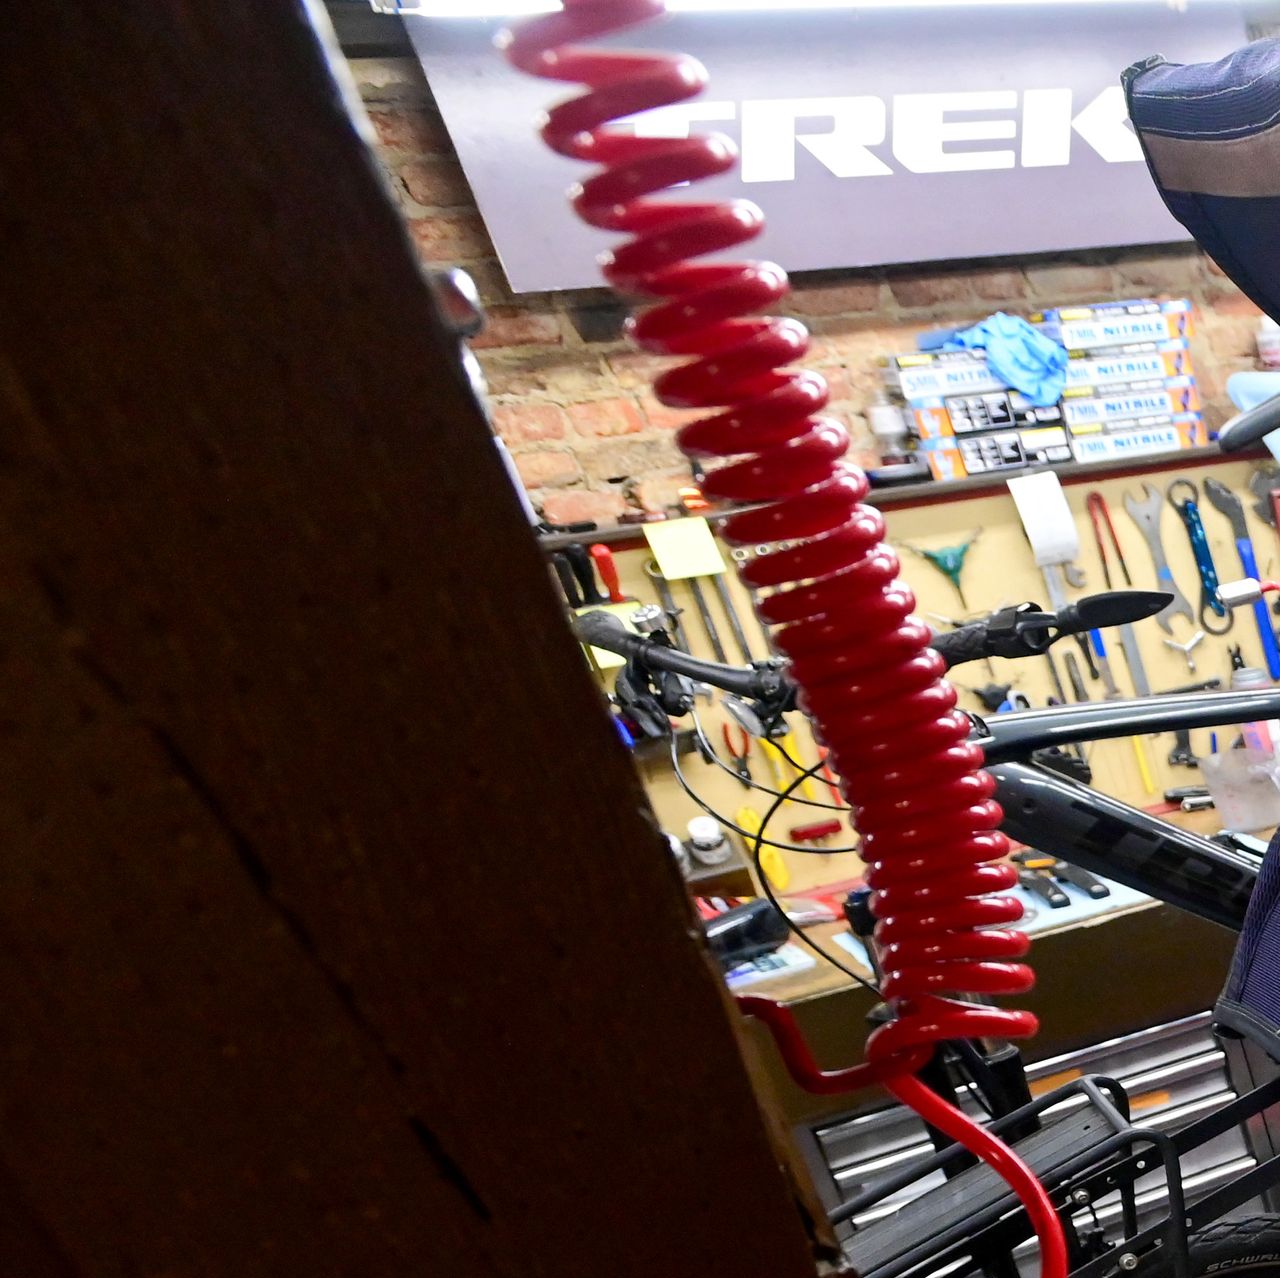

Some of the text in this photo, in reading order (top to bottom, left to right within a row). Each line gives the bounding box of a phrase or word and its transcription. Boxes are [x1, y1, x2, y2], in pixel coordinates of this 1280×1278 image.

[1103, 322, 1165, 338] NITRILE
[1099, 360, 1161, 377] NITRILE
[1104, 397, 1168, 414] NITRILE
[1112, 432, 1176, 450] NITRILE
